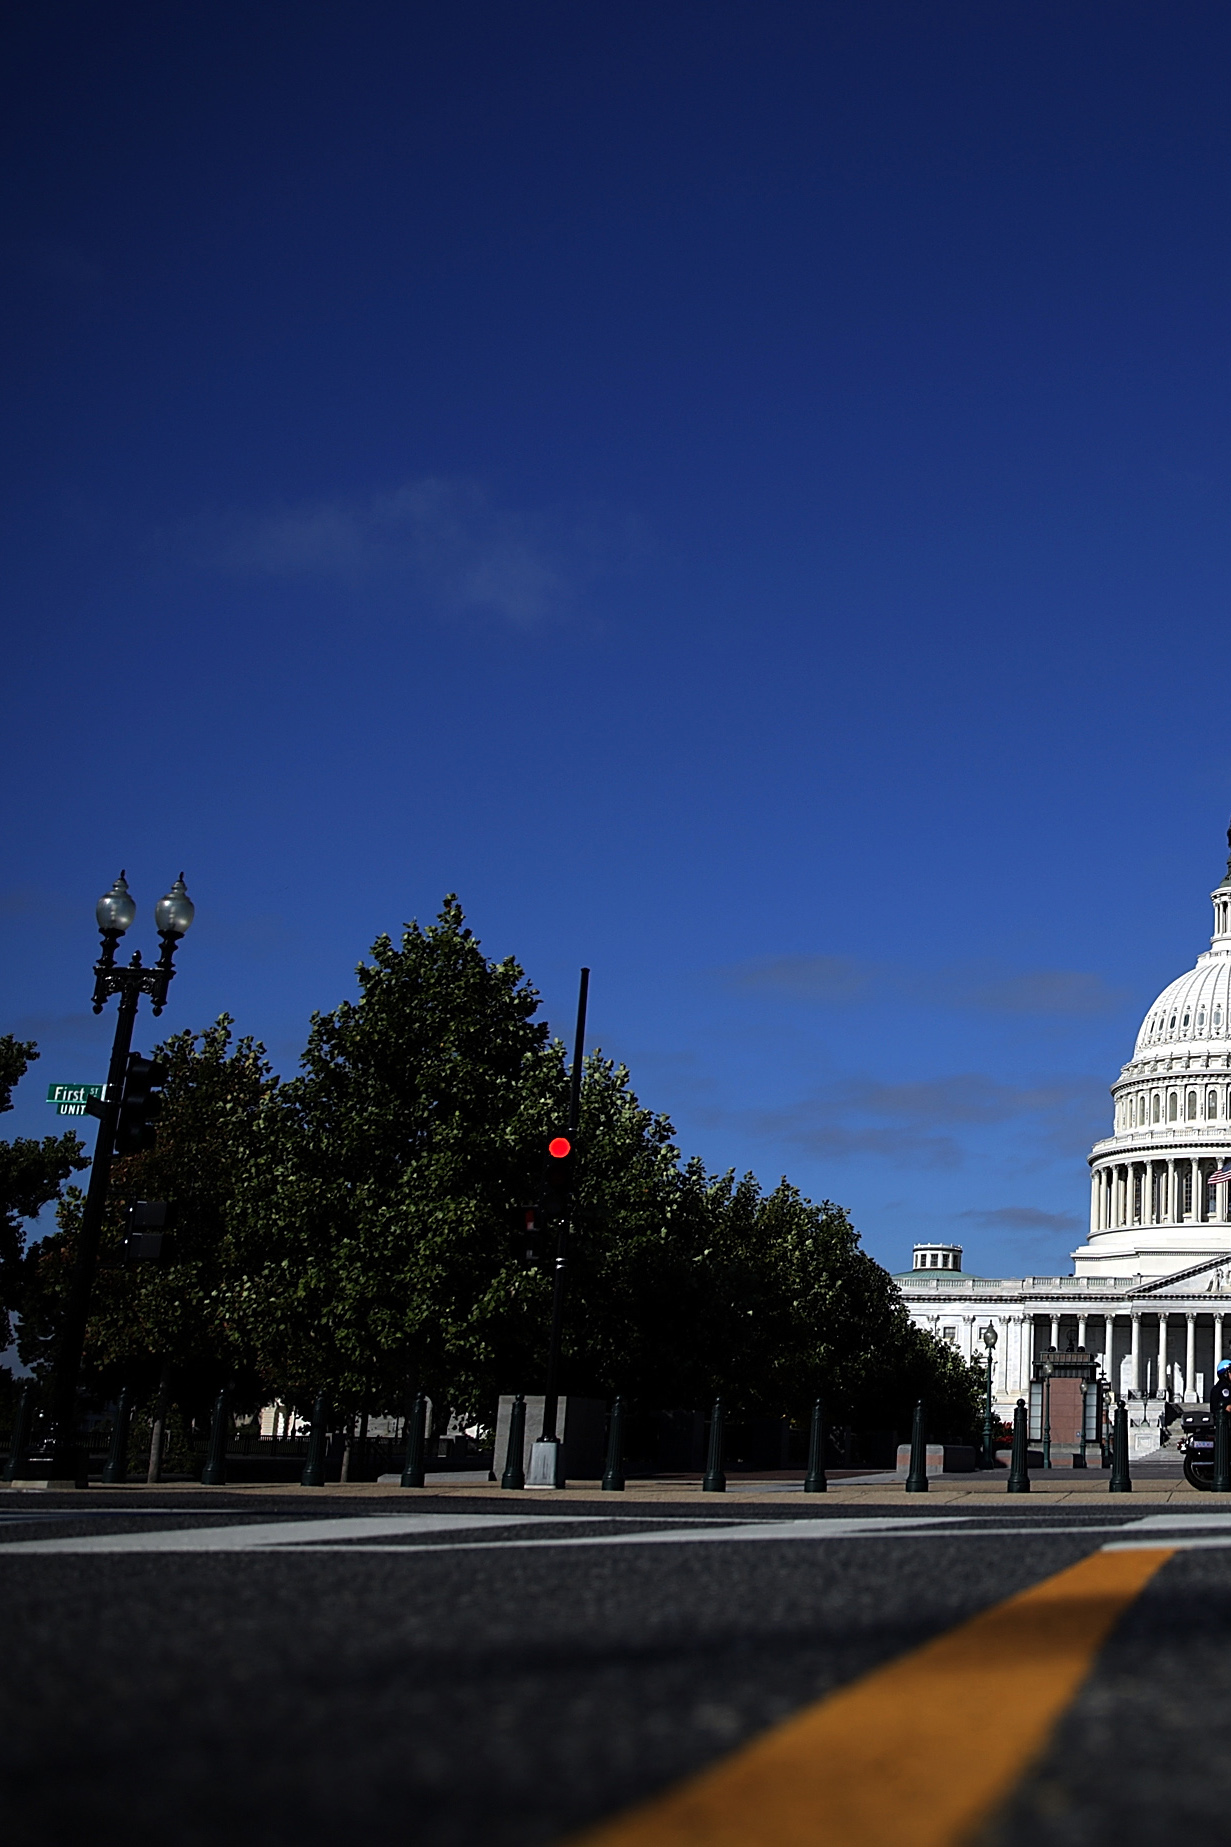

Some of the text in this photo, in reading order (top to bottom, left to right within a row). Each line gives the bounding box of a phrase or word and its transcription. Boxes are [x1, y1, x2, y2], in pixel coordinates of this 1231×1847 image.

[54, 1086, 99, 1101] First ST
[60, 1104, 86, 1115] UNIT
